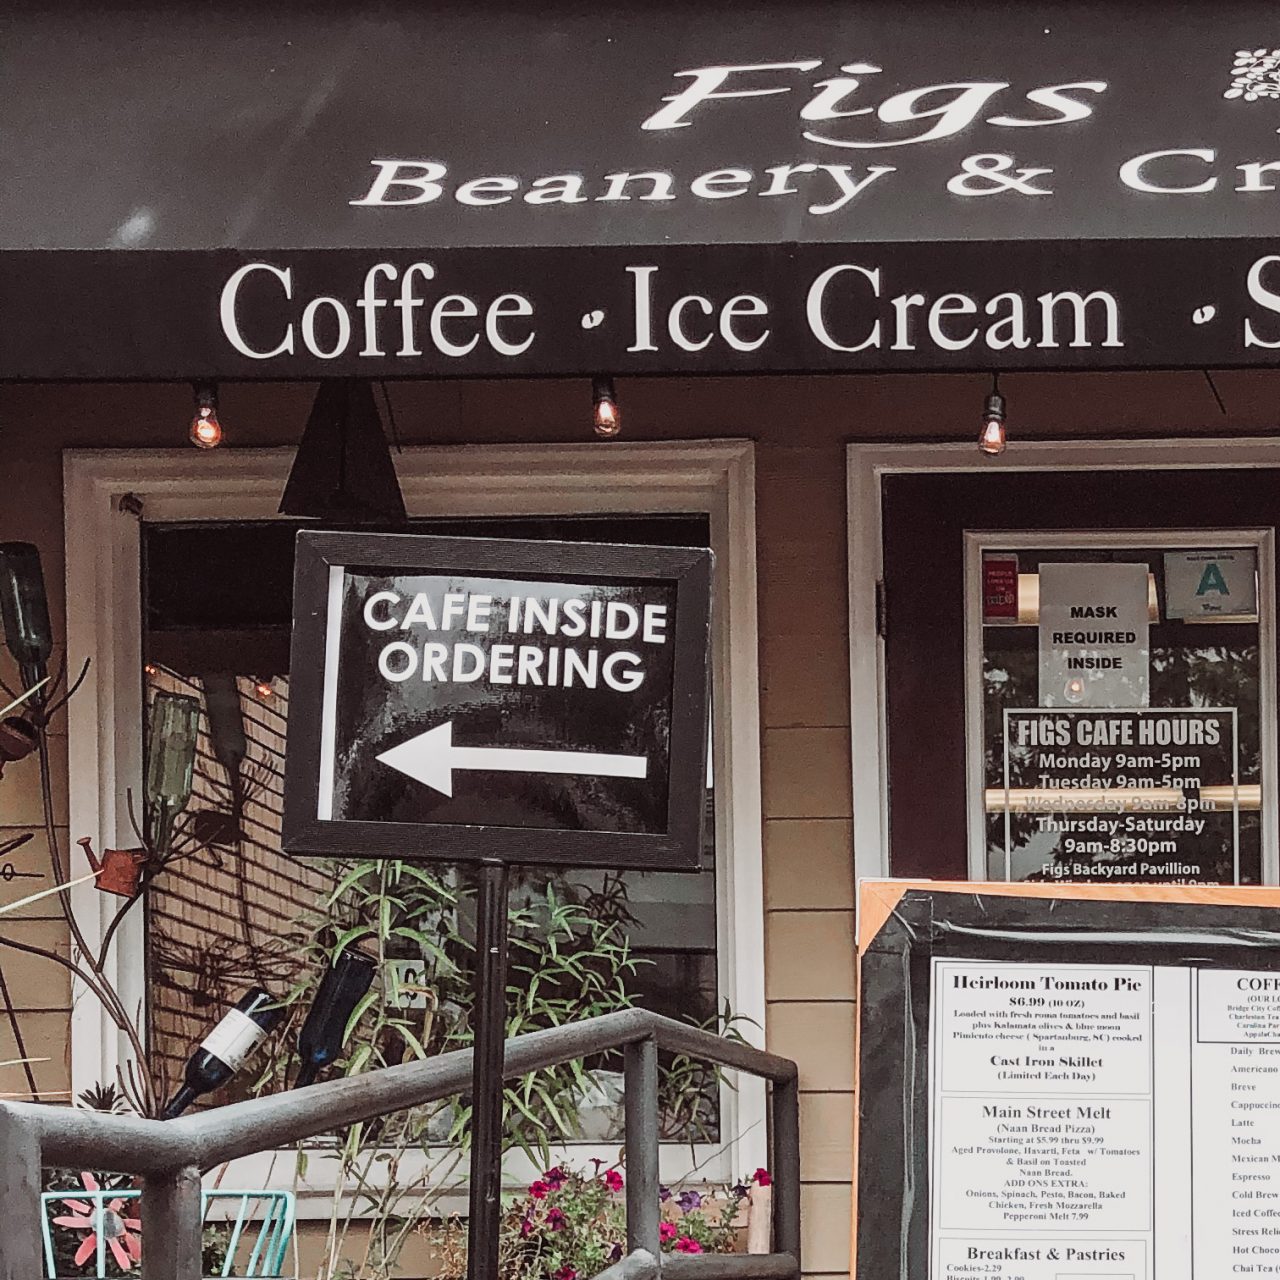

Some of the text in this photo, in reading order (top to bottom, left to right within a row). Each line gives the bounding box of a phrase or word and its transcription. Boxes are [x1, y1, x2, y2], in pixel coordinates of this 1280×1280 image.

[640, 59, 1108, 149] Figs
[349, 160, 897, 215] Beanery
[946, 152, 1054, 198] &
[218, 262, 537, 360] Coffee
[624, 264, 771, 354] Ice
[805, 263, 1125, 353] Cream
[1195, 563, 1231, 596] A
[363, 591, 668, 644] CAFE INSIDE
[1069, 605, 1118, 619] MASK
[1052, 631, 1137, 645] REQUIRED
[377, 641, 646, 693] ORDERING
[1067, 656, 1124, 670] INSIDE
[1017, 717, 1220, 746] FIGS CAFE HOURS
[1039, 752, 1201, 772] Monday 9am-5pm
[1039, 775, 1112, 793] Tuesday
[1025, 795, 1126, 815] Wednesday
[1035, 816, 1206, 835] Thursday-Saturday
[1064, 837, 1177, 857] 9am-8:30pm
[1041, 862, 1201, 879] Figs Backyard Pavillion
[953, 975, 1142, 992] Heirloom Tomato Pie
[1230, 1046, 1253, 1057] Daily
[989, 1055, 1103, 1068] Cast Iron Skillet
[982, 1105, 1111, 1120] Main Street Melt
[996, 1123, 1096, 1135] (Naan Bread Pizza)
[967, 1246, 1126, 1261] Breakfast & Pastries
